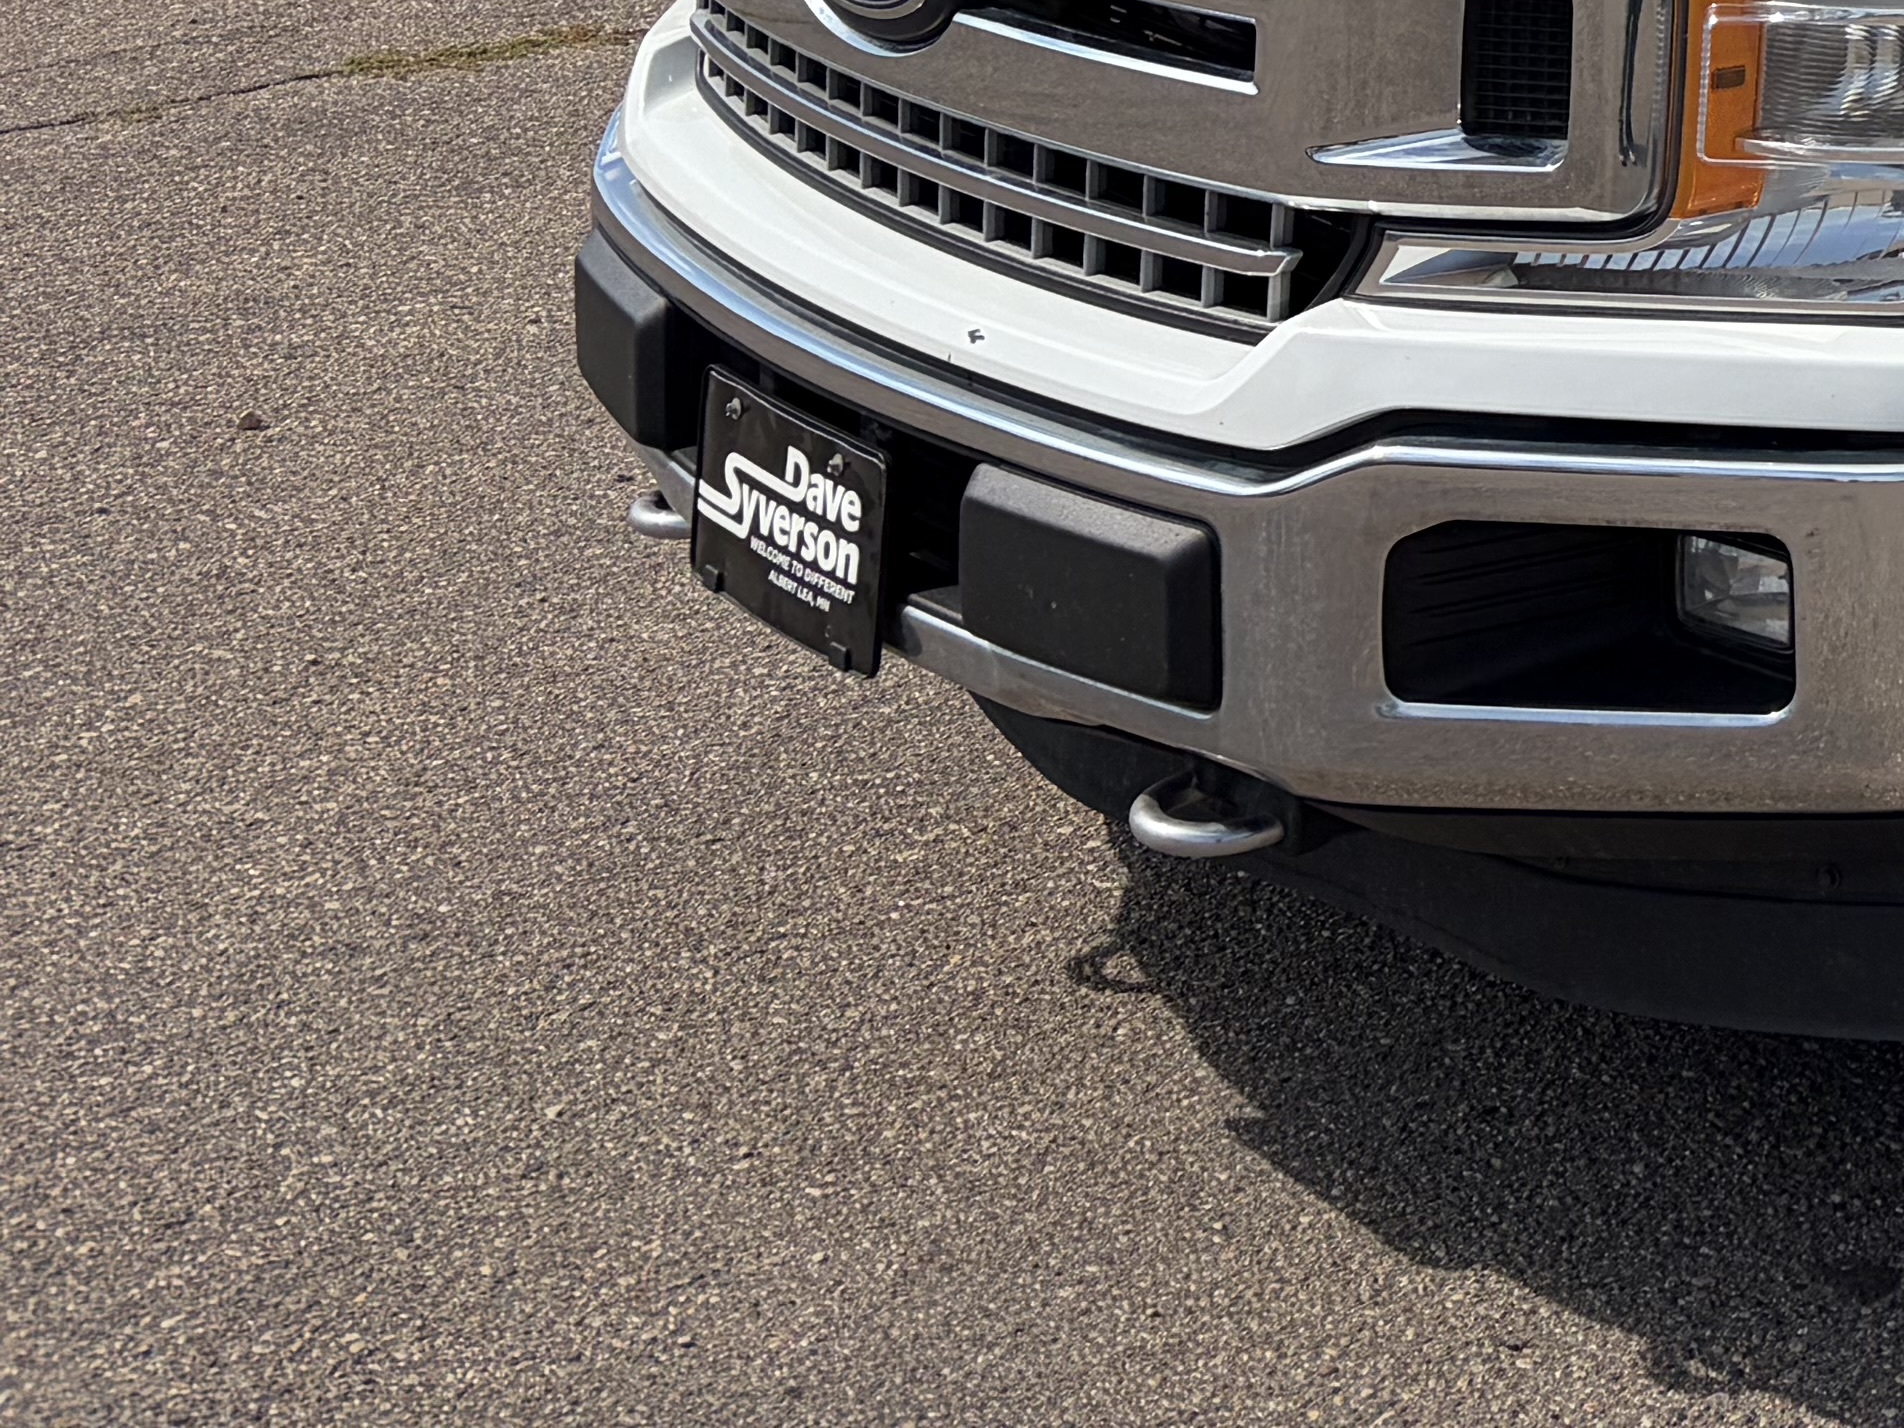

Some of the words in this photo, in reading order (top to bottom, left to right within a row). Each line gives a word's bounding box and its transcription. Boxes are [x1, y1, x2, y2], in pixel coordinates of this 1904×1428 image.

[698, 451, 860, 585] Syverson
[784, 445, 861, 532] Dave
[750, 535, 791, 571] WELCOME
[791, 560, 803, 577] TO
[804, 568, 855, 604] DIFFERENT
[768, 569, 798, 594] ALBERT
[797, 585, 814, 607] LEA,
